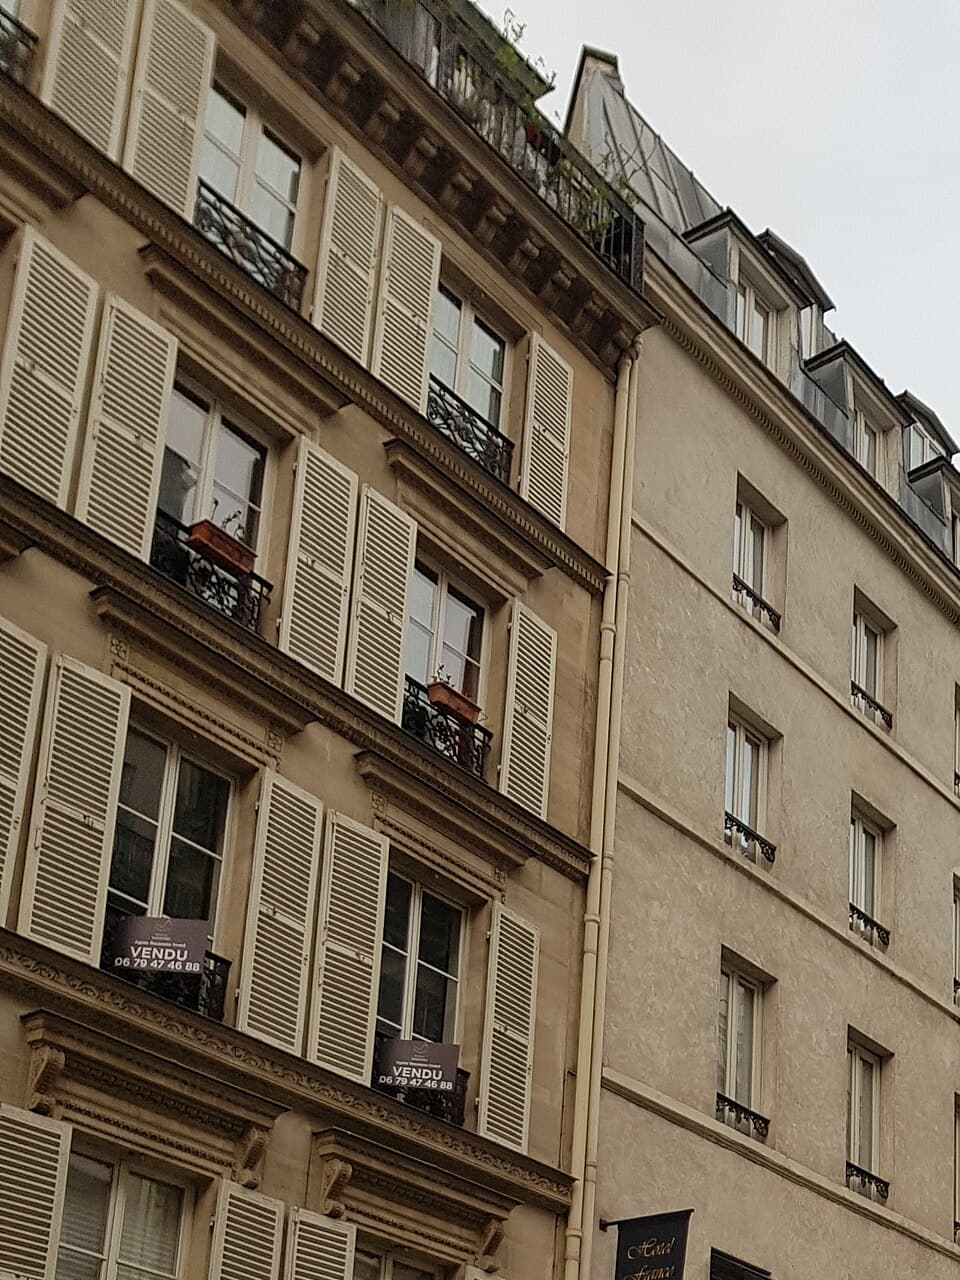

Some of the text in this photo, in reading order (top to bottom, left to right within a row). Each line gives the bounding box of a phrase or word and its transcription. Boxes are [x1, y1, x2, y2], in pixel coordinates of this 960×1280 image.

[130, 946, 188, 961] VENDU
[115, 957, 200, 971] 06 79 47 46 88
[393, 1066, 443, 1081] VENDU
[379, 1076, 453, 1090] 06 79 47 46 88
